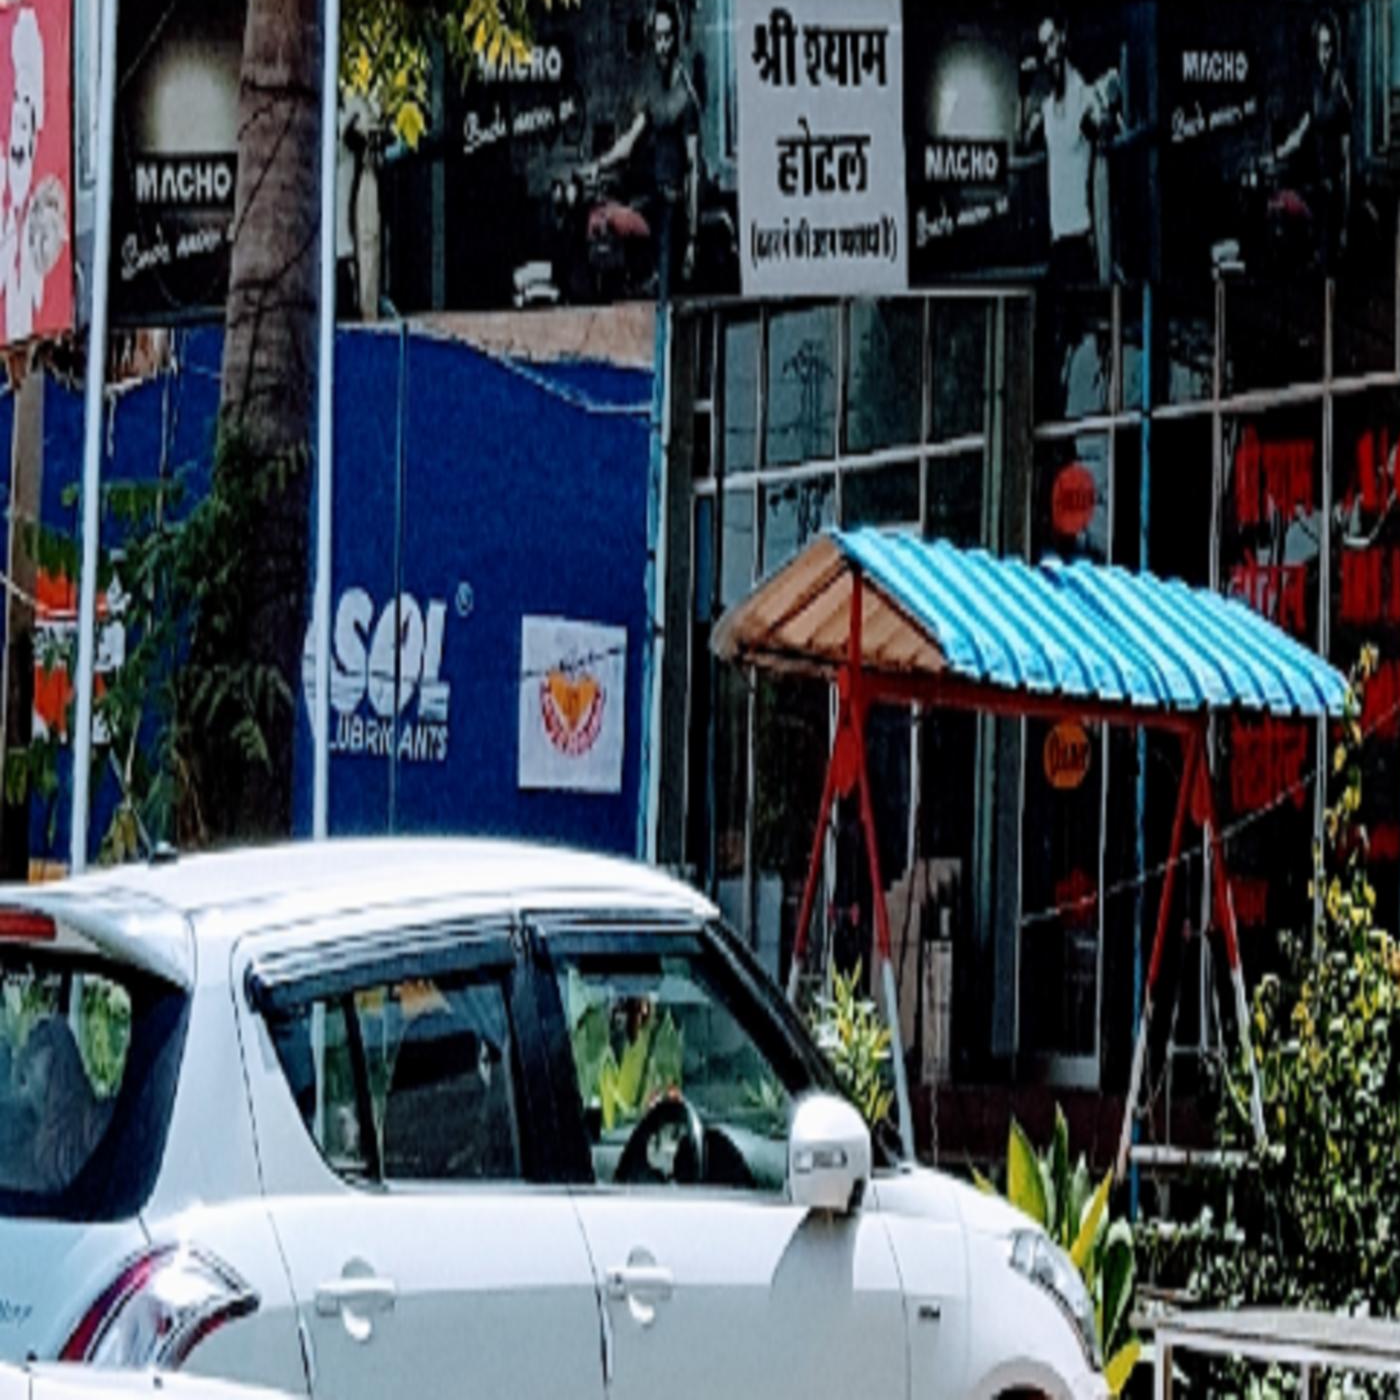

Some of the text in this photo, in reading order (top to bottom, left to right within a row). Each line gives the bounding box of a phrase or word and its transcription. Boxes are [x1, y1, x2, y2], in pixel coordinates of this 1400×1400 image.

[752, 7, 890, 87] श्री श्याम
[1182, 49, 1249, 83] MACHO
[775, 115, 872, 197] होटल
[924, 145, 999, 182] MACHO
[136, 162, 233, 203] MACHO
